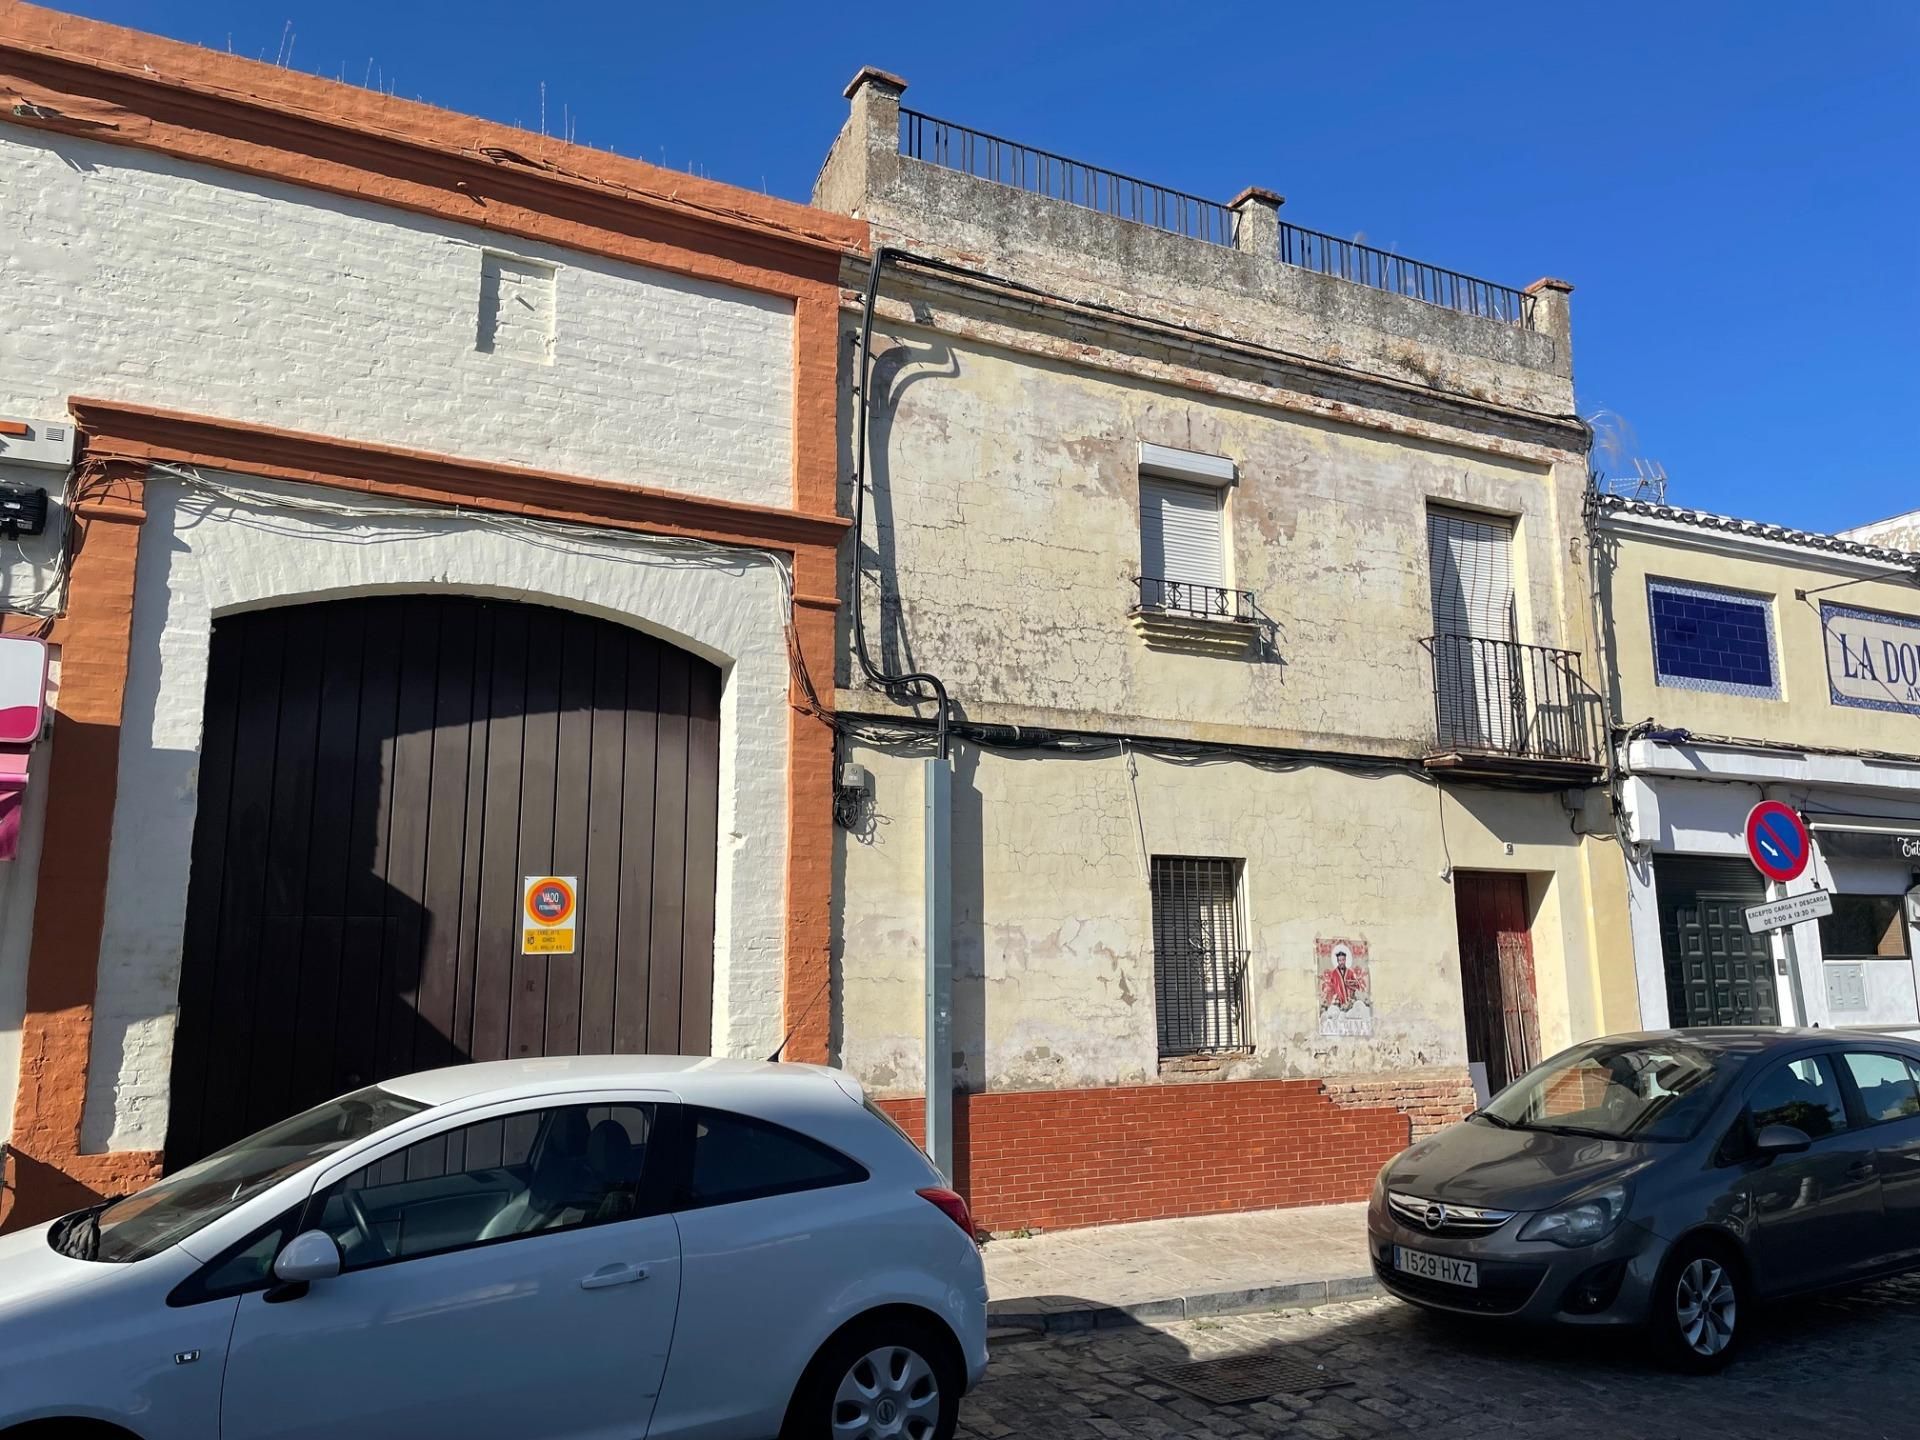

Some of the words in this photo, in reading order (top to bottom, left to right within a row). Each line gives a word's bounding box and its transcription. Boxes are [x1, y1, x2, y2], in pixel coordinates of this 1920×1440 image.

[1839, 633, 1877, 681] LA
[542, 892, 559, 903] VADO
[1748, 908, 1773, 919] EXCEPTO
[1774, 903, 1793, 913] CARGA
[1799, 895, 1828, 907] DESCARGA
[1404, 1251, 1437, 1276] 1529
[1441, 1259, 1473, 1284] HXZ
